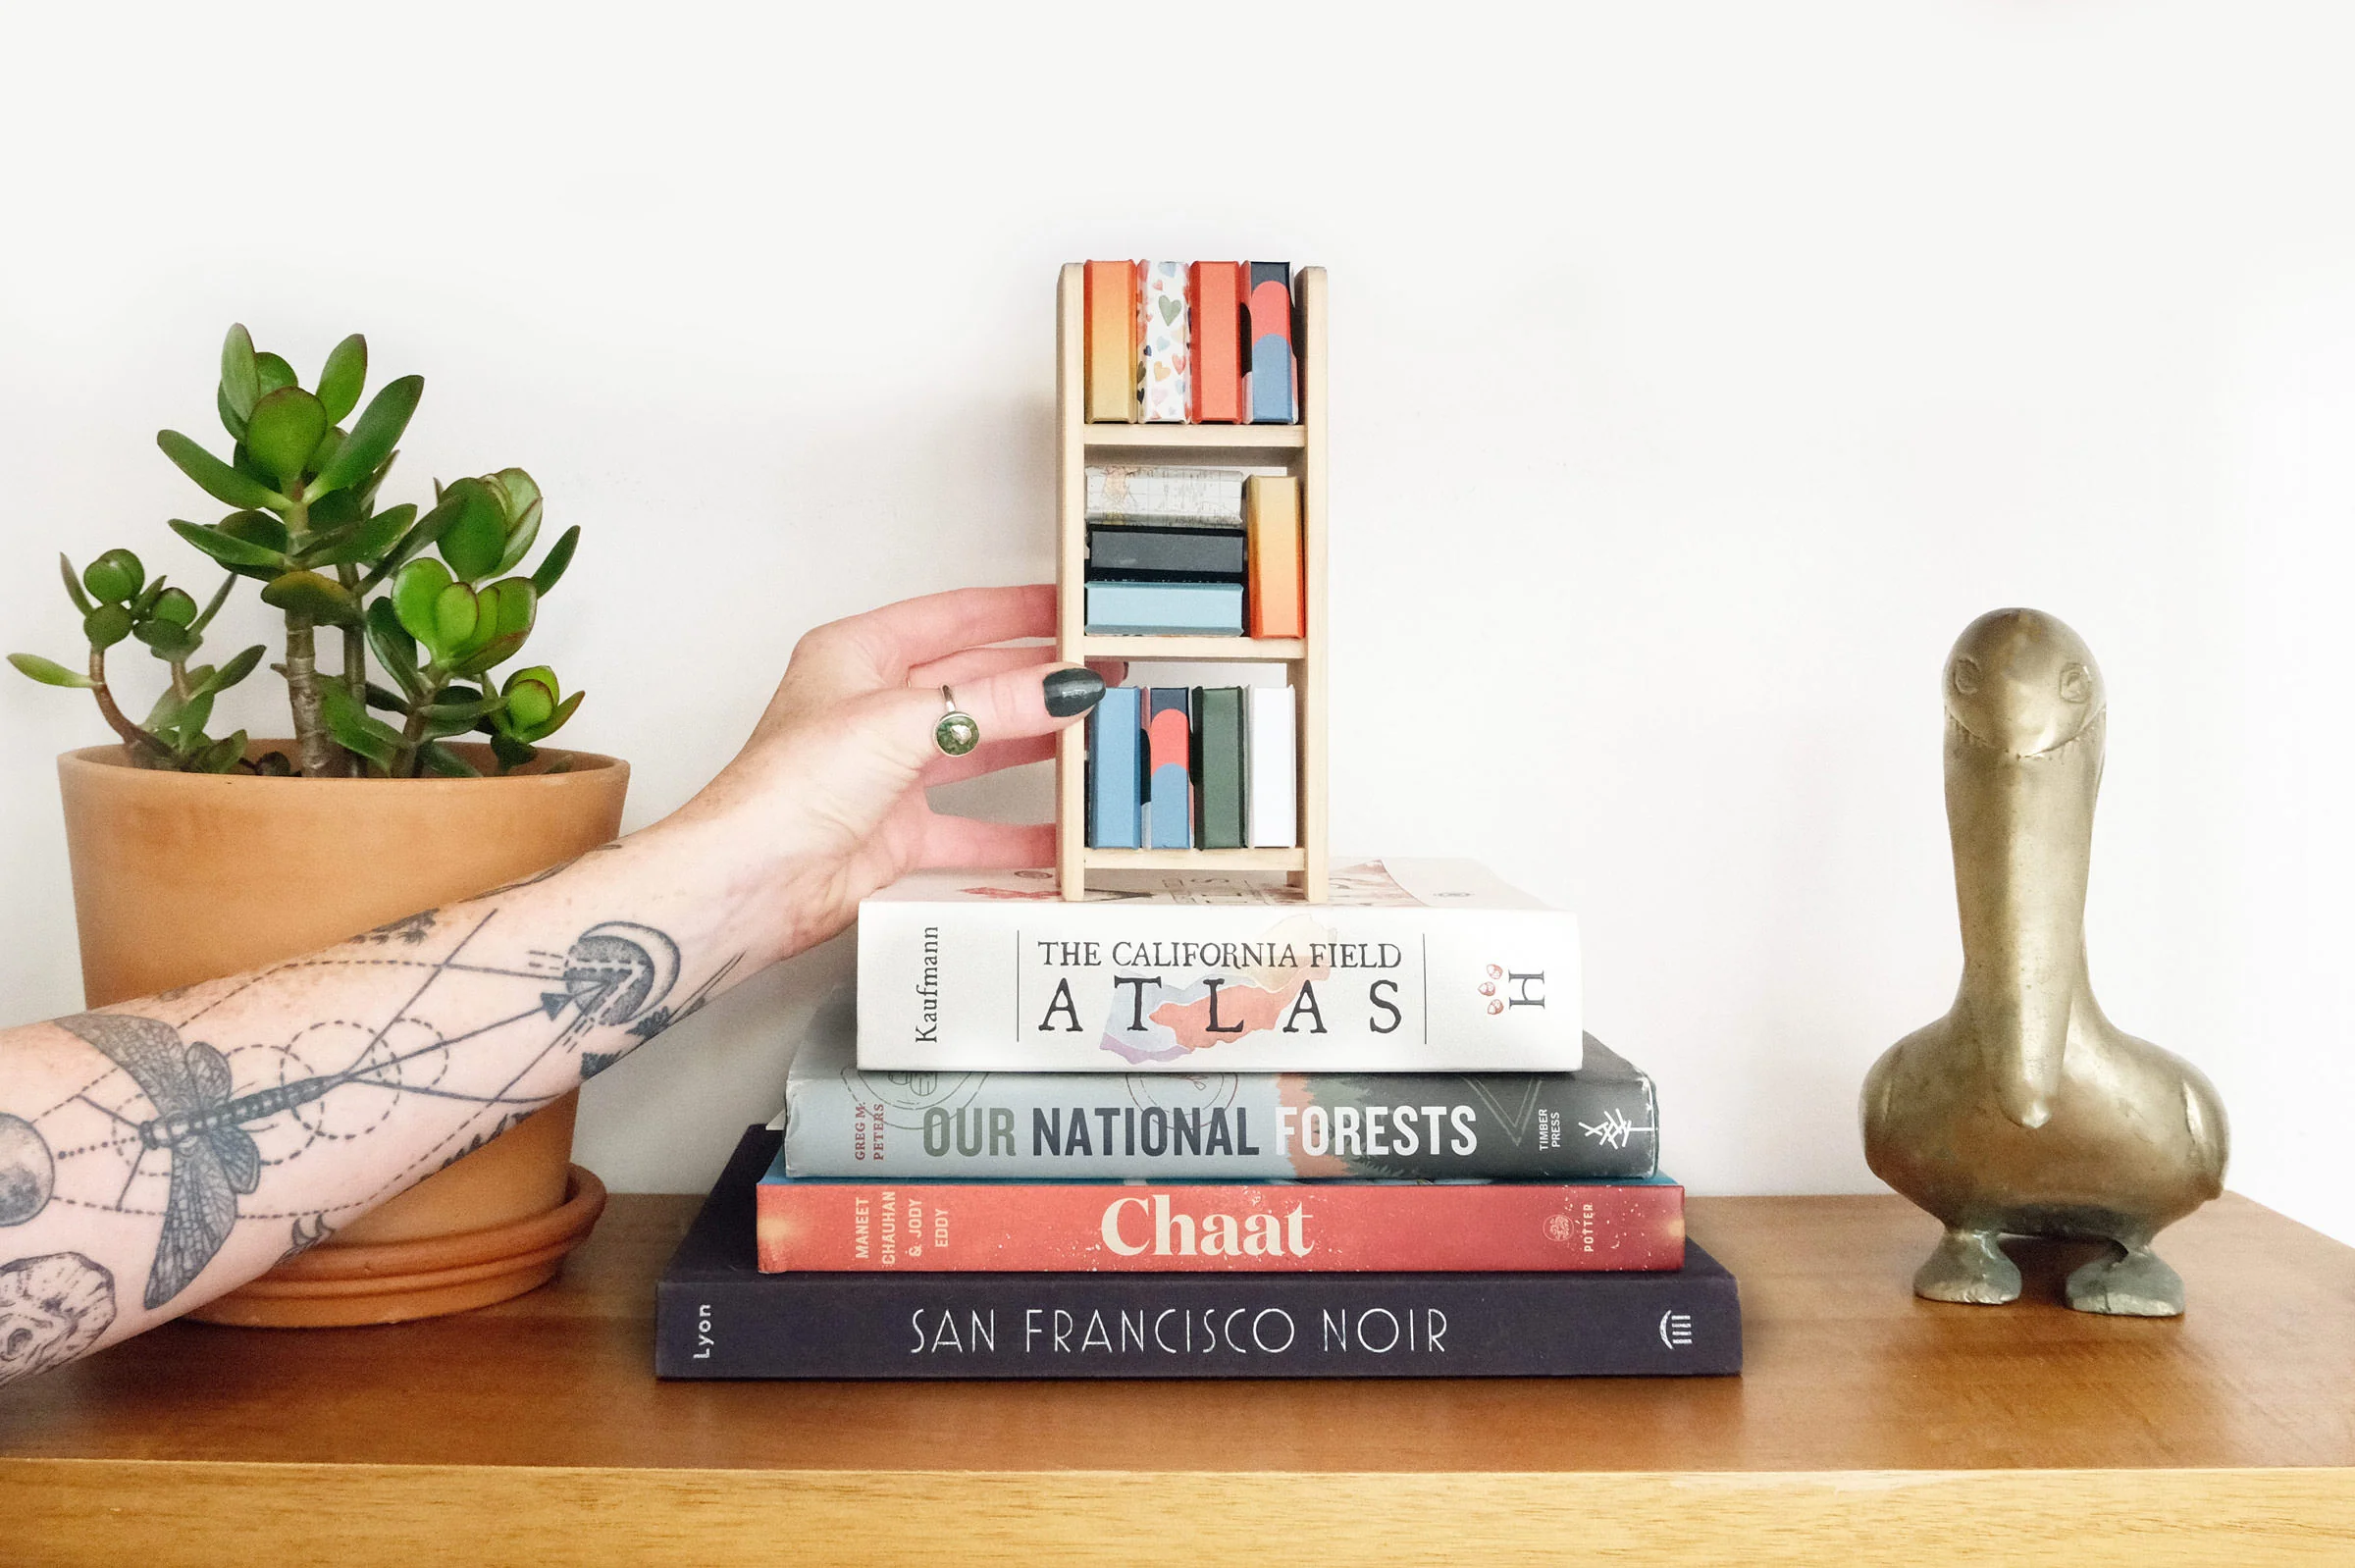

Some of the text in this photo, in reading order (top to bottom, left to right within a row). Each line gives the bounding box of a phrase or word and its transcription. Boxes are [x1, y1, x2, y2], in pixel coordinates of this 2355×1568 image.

[1038, 941, 1402, 968] THE CALIFORNIA FIELD
[915, 926, 938, 1043] Kaufmann
[855, 1121, 867, 1161] GREG
[872, 1103, 885, 1161] PETERS
[922, 1105, 1478, 1157] OUR NATIONAL FORESTS
[1539, 1109, 1548, 1151] TIMBER
[1551, 1111, 1561, 1148] PRESS
[856, 1197, 870, 1259] MANEET
[882, 1190, 896, 1266] CHAUHAN
[909, 1198, 923, 1257] & JODY
[935, 1208, 950, 1248] EDDY
[1101, 1193, 1315, 1257] Chaat
[1584, 1203, 1595, 1252] POTTER
[693, 1304, 714, 1359] Lyon
[911, 1308, 1447, 1353] SAN FRANCISCO NOIR
